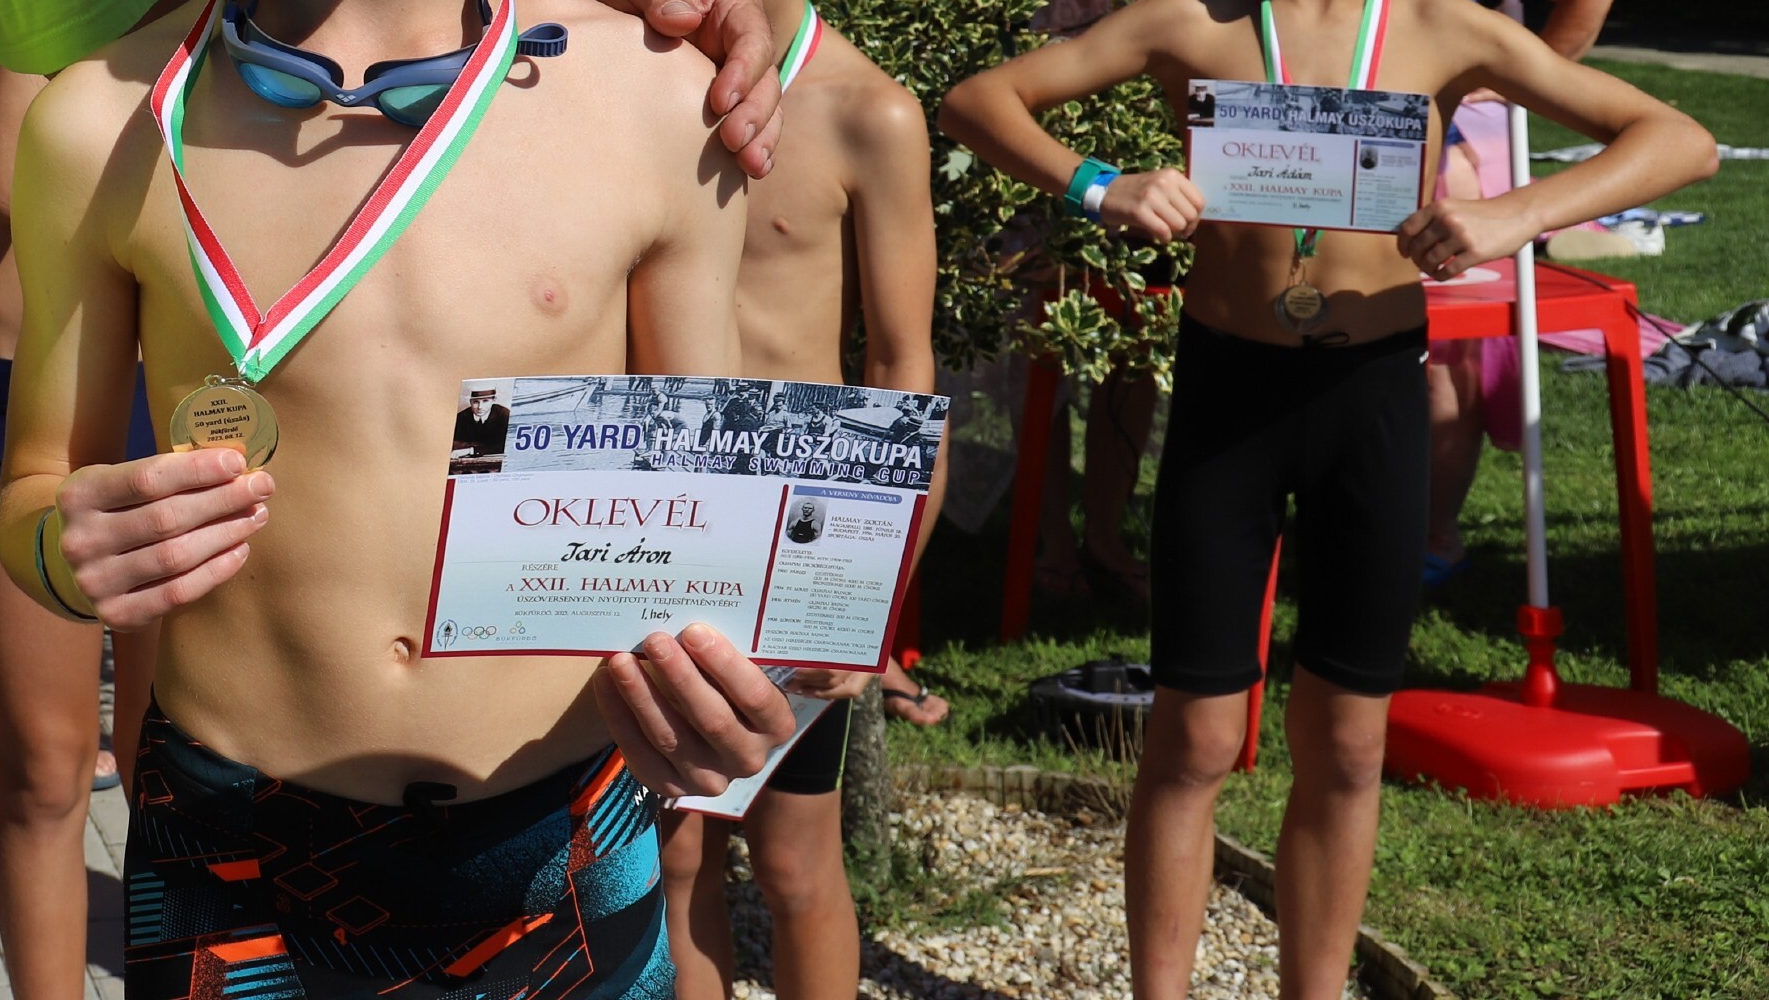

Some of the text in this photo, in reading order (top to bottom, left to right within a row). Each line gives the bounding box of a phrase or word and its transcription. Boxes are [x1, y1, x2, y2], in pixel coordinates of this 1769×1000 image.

[1220, 105, 1237, 118] 50
[1243, 106, 1280, 120] YARD
[1288, 110, 1345, 125] HALMAY
[1222, 142, 1321, 162] OKLEVÉL
[1260, 184, 1308, 195] HALMAY
[1313, 187, 1343, 197] KUPA
[194, 404, 247, 417] HALMAY KUPA
[205, 419, 222, 428] yard
[514, 425, 552, 451] 50
[563, 424, 642, 451] YARD
[655, 427, 769, 455] HALMAY
[651, 453, 921, 485] HALMAY SWIMMING CUP
[829, 490, 859, 498] VERSENY
[513, 493, 708, 532] OKLEVÉL
[831, 516, 893, 527] HALMAY ZOLTÁN
[614, 537, 672, 565] Áron
[521, 563, 559, 572] RÉSZÉRE
[519, 577, 570, 592] XXII.
[579, 577, 676, 594] HALMAY
[685, 580, 744, 597] KUPA
[598, 595, 650, 605] NYÚJTOTT
[653, 596, 741, 608] TELJESÍTMÉNYÉÉRT
[650, 608, 674, 624] hely
